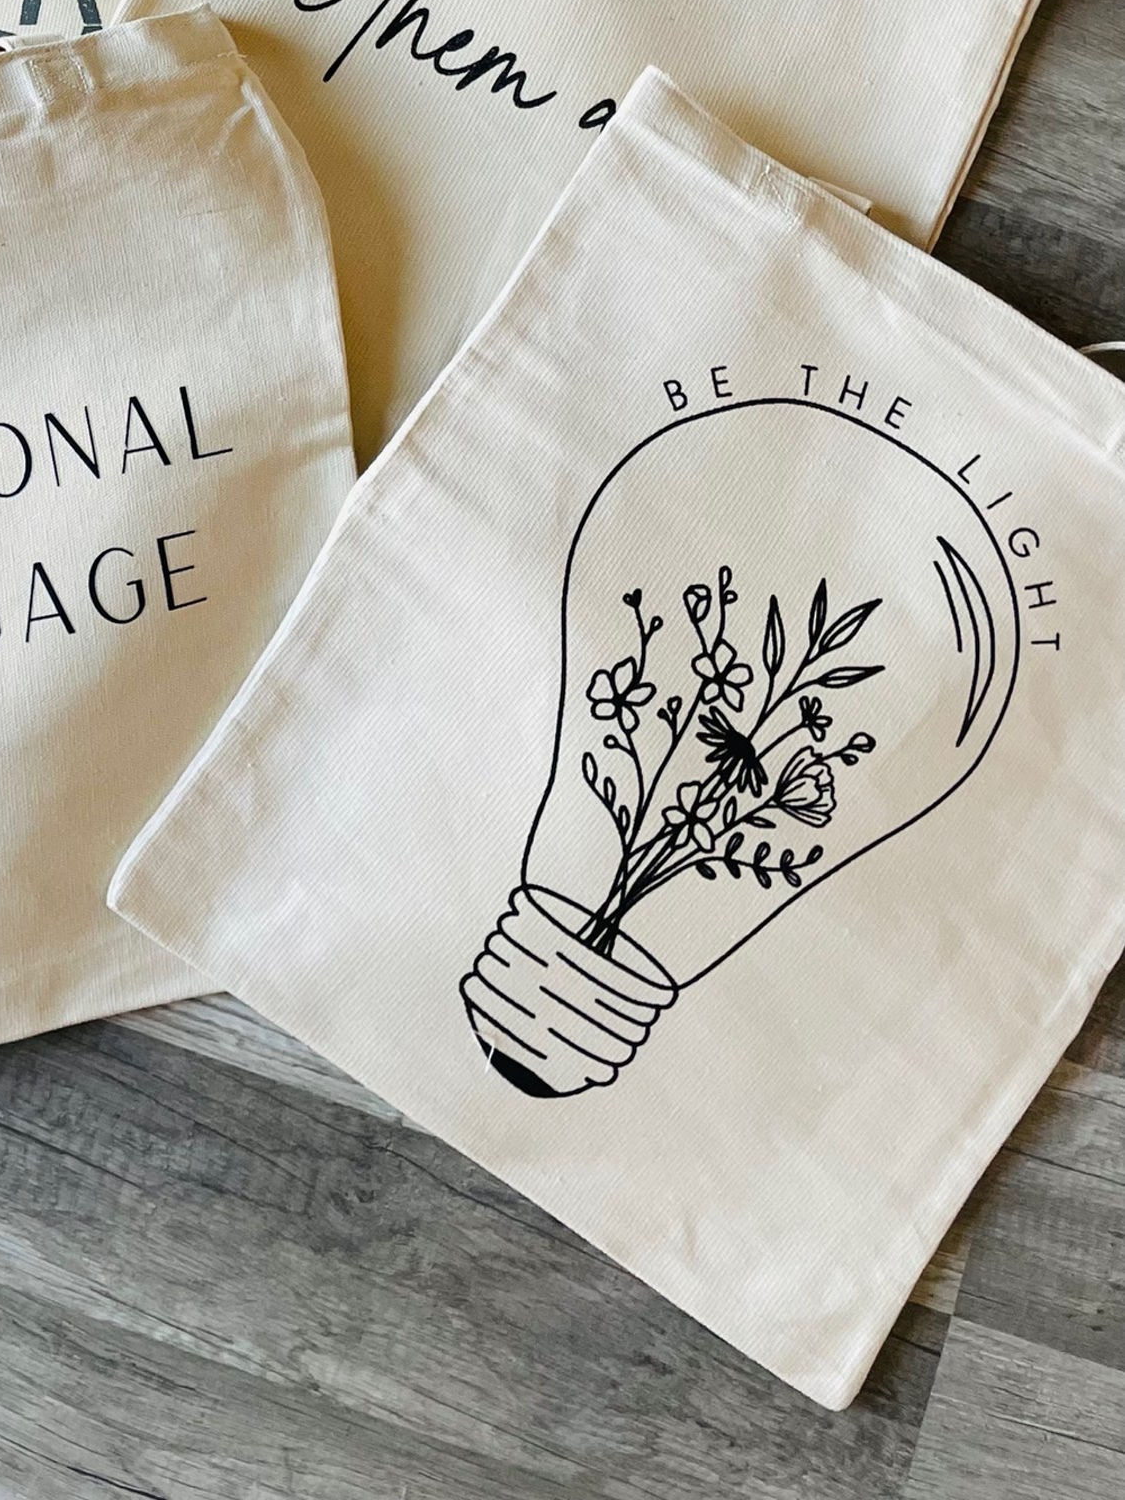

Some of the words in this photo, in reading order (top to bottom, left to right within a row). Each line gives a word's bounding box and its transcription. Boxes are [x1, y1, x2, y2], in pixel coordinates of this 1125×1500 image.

[663, 366, 733, 411] BE
[801, 364, 913, 429] THE
[957, 454, 1060, 651] LIGHT
